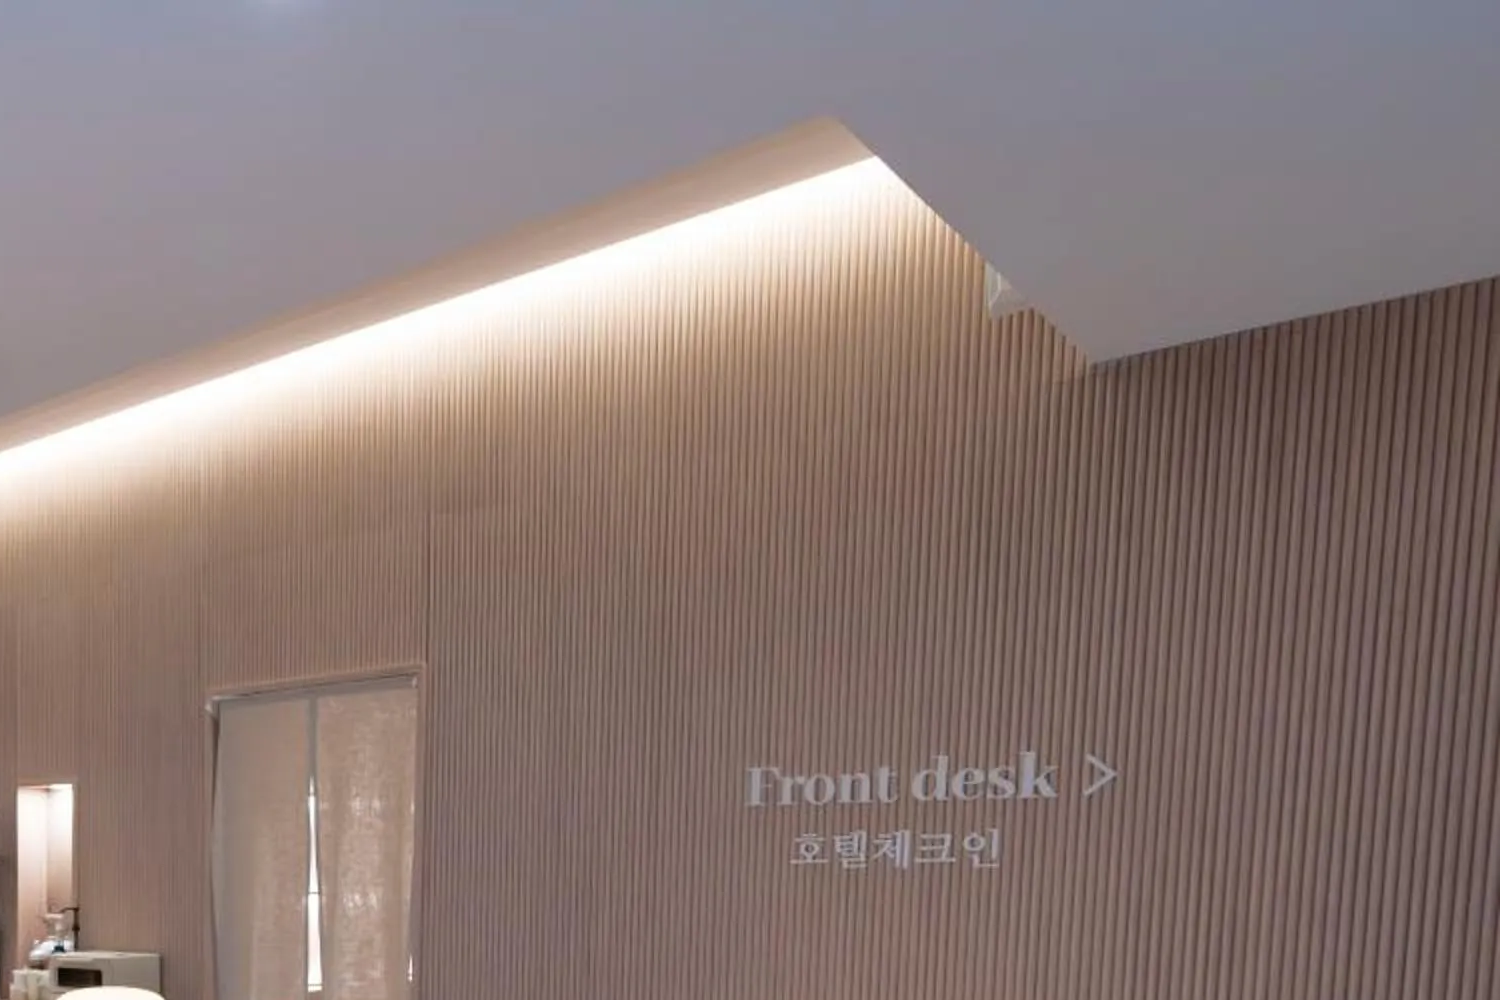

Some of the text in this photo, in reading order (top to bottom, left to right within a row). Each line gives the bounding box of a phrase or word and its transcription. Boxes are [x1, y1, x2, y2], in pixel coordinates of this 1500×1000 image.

[745, 751, 1058, 806] Front desk
[790, 828, 1000, 869] 호텔체크인
